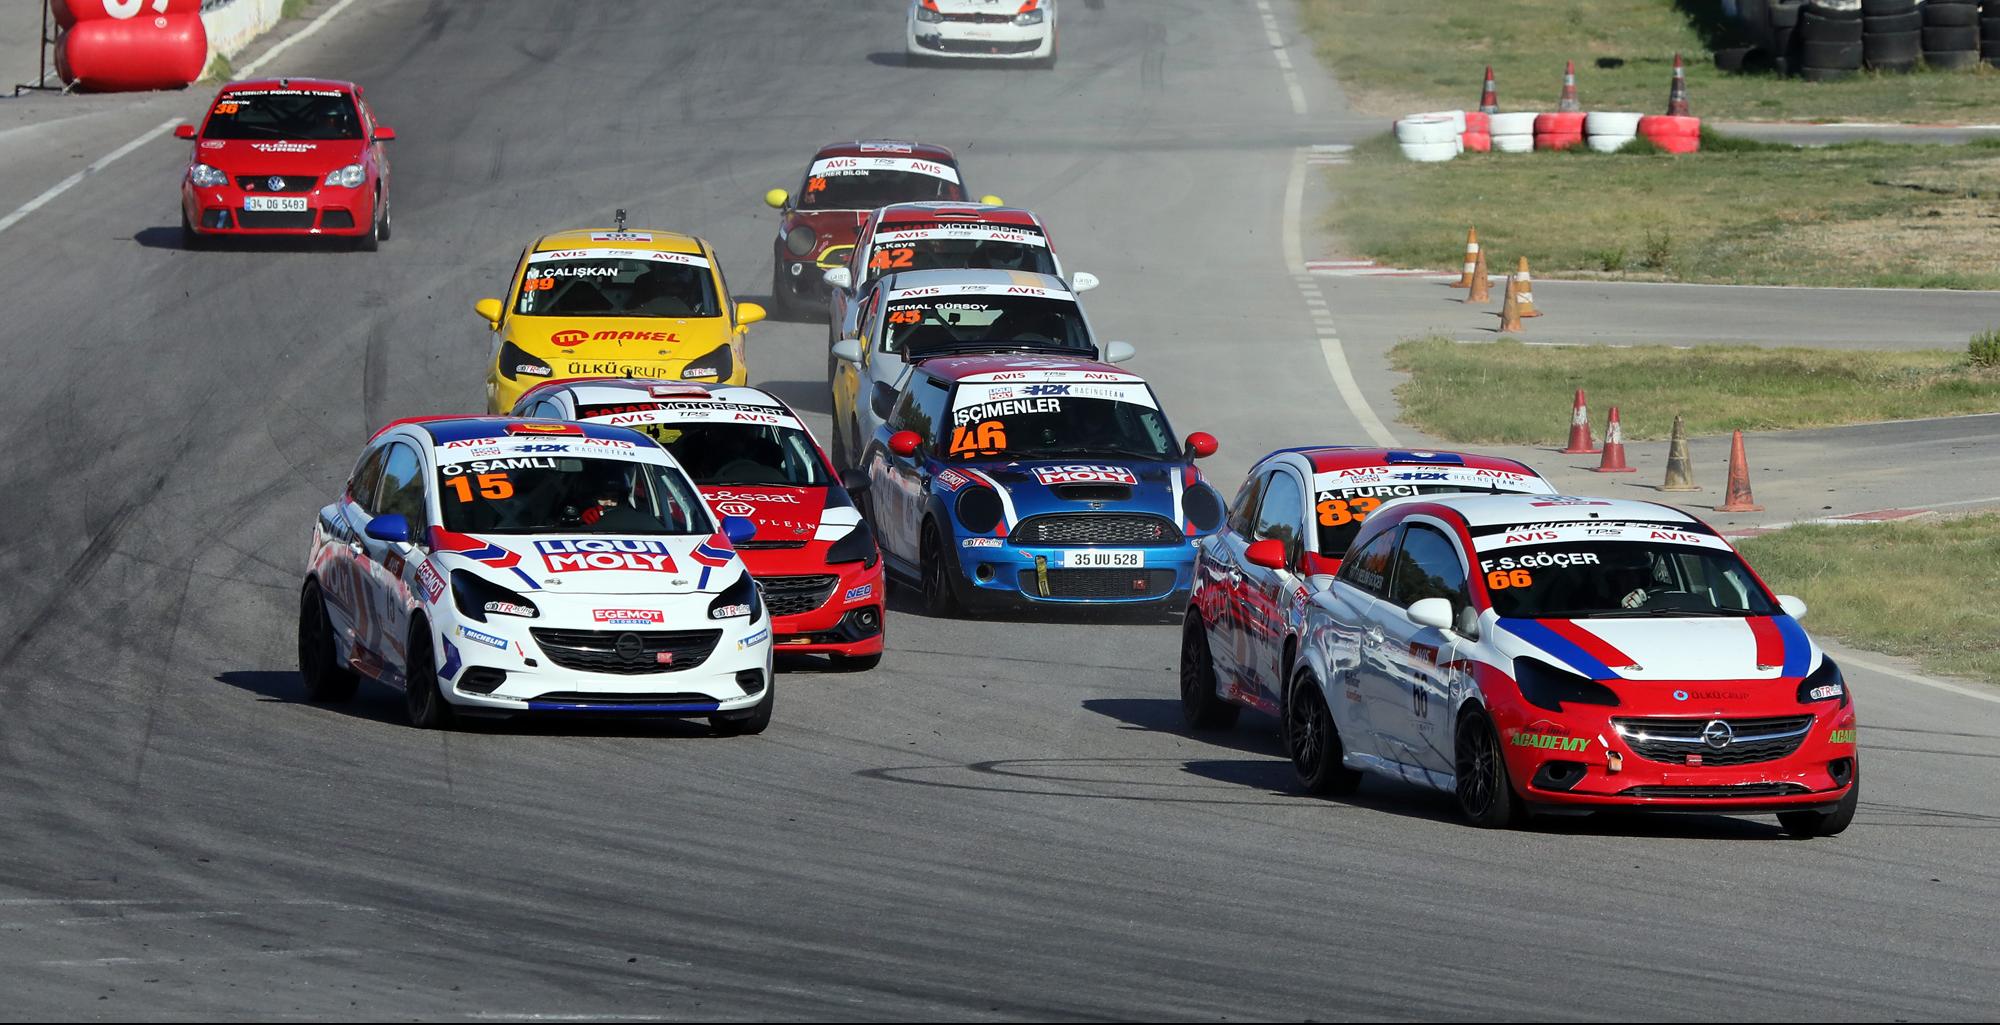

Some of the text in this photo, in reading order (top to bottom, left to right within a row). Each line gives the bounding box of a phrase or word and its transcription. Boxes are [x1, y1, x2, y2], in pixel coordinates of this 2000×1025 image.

[214, 104, 239, 115] 36
[826, 159, 857, 169] AVIS
[911, 161, 941, 174] AVIS
[251, 200, 262, 210] 34
[894, 231, 929, 240] AVIS
[990, 232, 1025, 242] AVIS
[874, 241, 916, 252] A.Kaya
[550, 250, 587, 259] AVIS
[652, 253, 690, 263] AVIS
[869, 249, 914, 270] 42
[524, 277, 554, 293] 89
[901, 287, 940, 297] AVIS
[1008, 286, 1045, 296] AVIS
[888, 302, 989, 312] KEMAL GÜRSOY
[889, 309, 921, 324] 45
[593, 330, 680, 343] MAKEL
[992, 372, 1026, 382] AVIS
[1084, 372, 1118, 382] AVIS
[610, 413, 656, 425] AVIS
[734, 412, 779, 424] AVIS
[447, 437, 497, 449] AVIS
[584, 438, 633, 449] AVIS
[949, 420, 1007, 459] 46
[442, 457, 557, 476] Ö.ŞAMLI
[1041, 465, 1126, 475] LIQUI
[1340, 466, 1389, 477] AVIS
[1476, 469, 1524, 481] AVIS
[1042, 473, 1138, 485] MOLY
[445, 473, 515, 503] 15
[1318, 485, 1419, 502] A.FURCI
[1316, 497, 1382, 527] 83
[759, 519, 816, 530] PLEIN
[1505, 530, 1558, 544] AVIS
[1650, 530, 1701, 543] AVIS
[540, 539, 668, 554] LIQUI
[547, 553, 669, 571] MOLY
[1074, 553, 1138, 566] 35 UU 528
[1480, 551, 1601, 574] F.S.GÖÇER
[417, 562, 444, 597] EGEMOT
[1487, 569, 1532, 590] 66
[846, 584, 872, 599] NEO
[594, 610, 661, 620] EGEMOT
[466, 630, 505, 647] MICHELIN
[1511, 732, 1591, 752] ACADEMY
